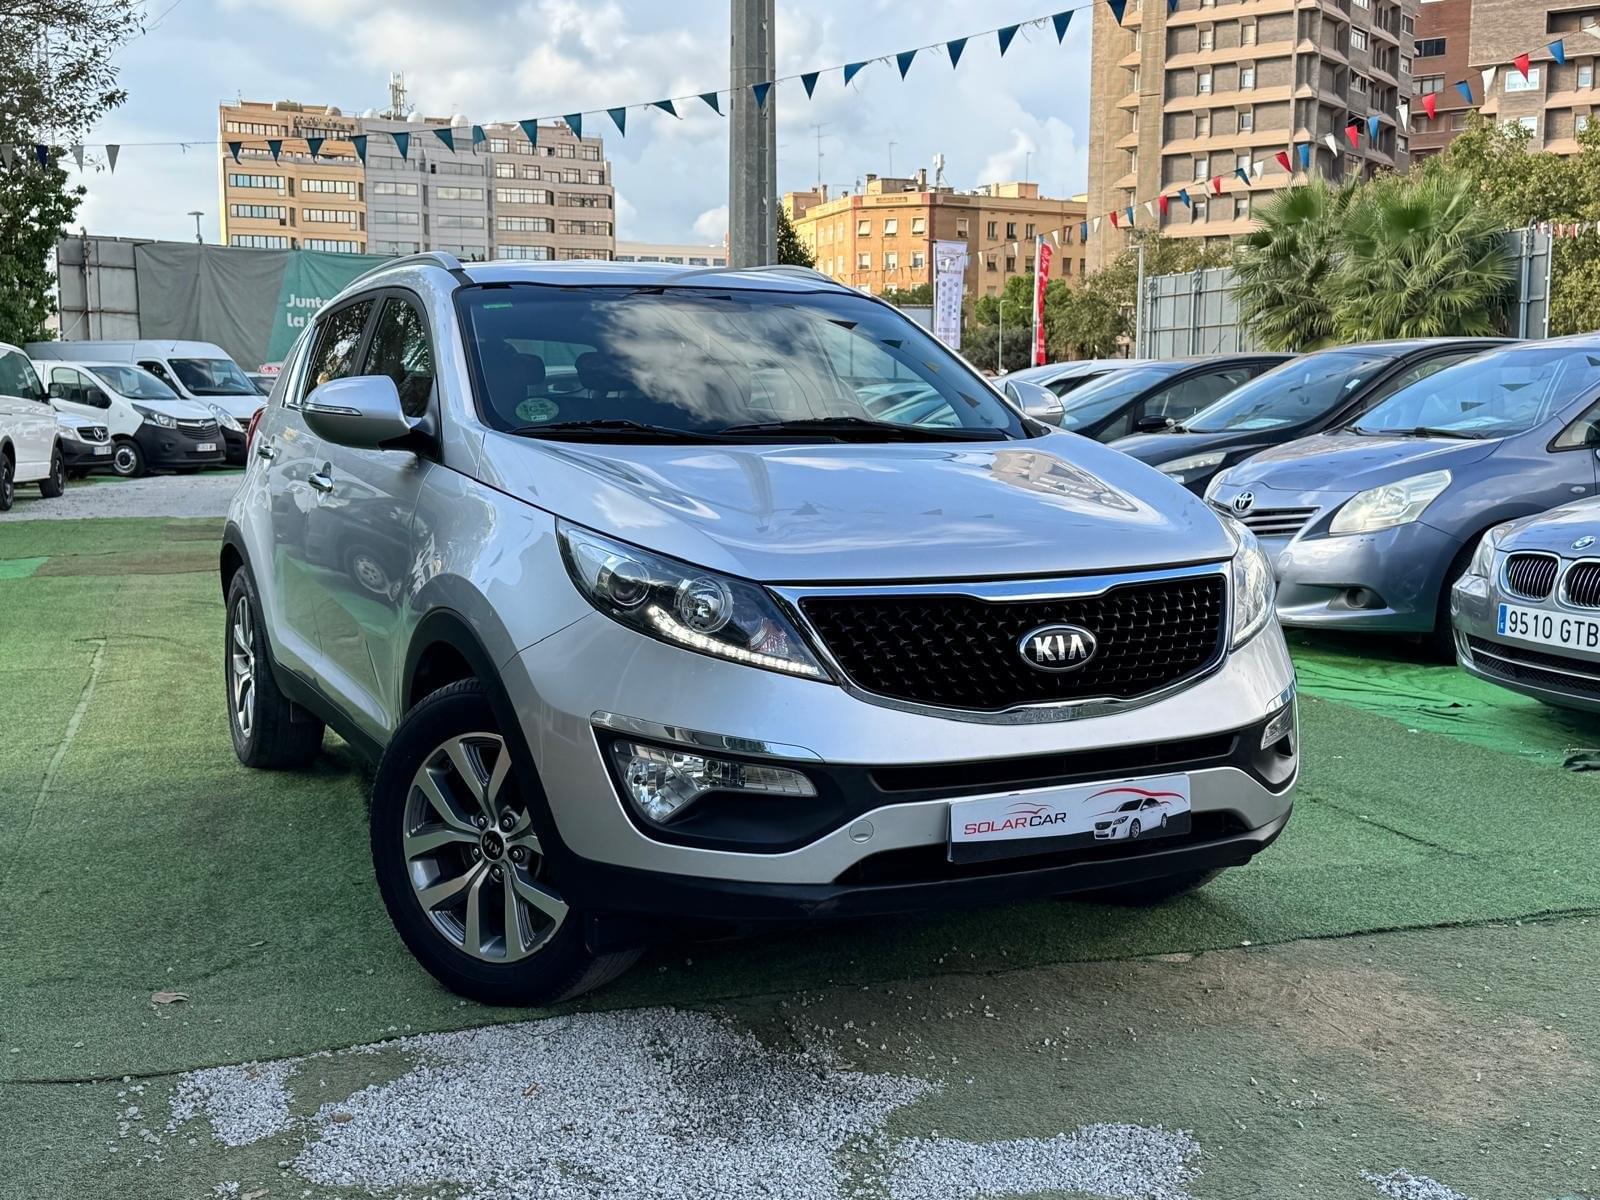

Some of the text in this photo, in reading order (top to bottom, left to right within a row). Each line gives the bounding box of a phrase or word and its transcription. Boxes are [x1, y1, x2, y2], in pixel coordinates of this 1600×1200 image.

[286, 312, 305, 328] la
[1508, 610, 1600, 648] 9510 GTB
[1033, 634, 1087, 662] KIA
